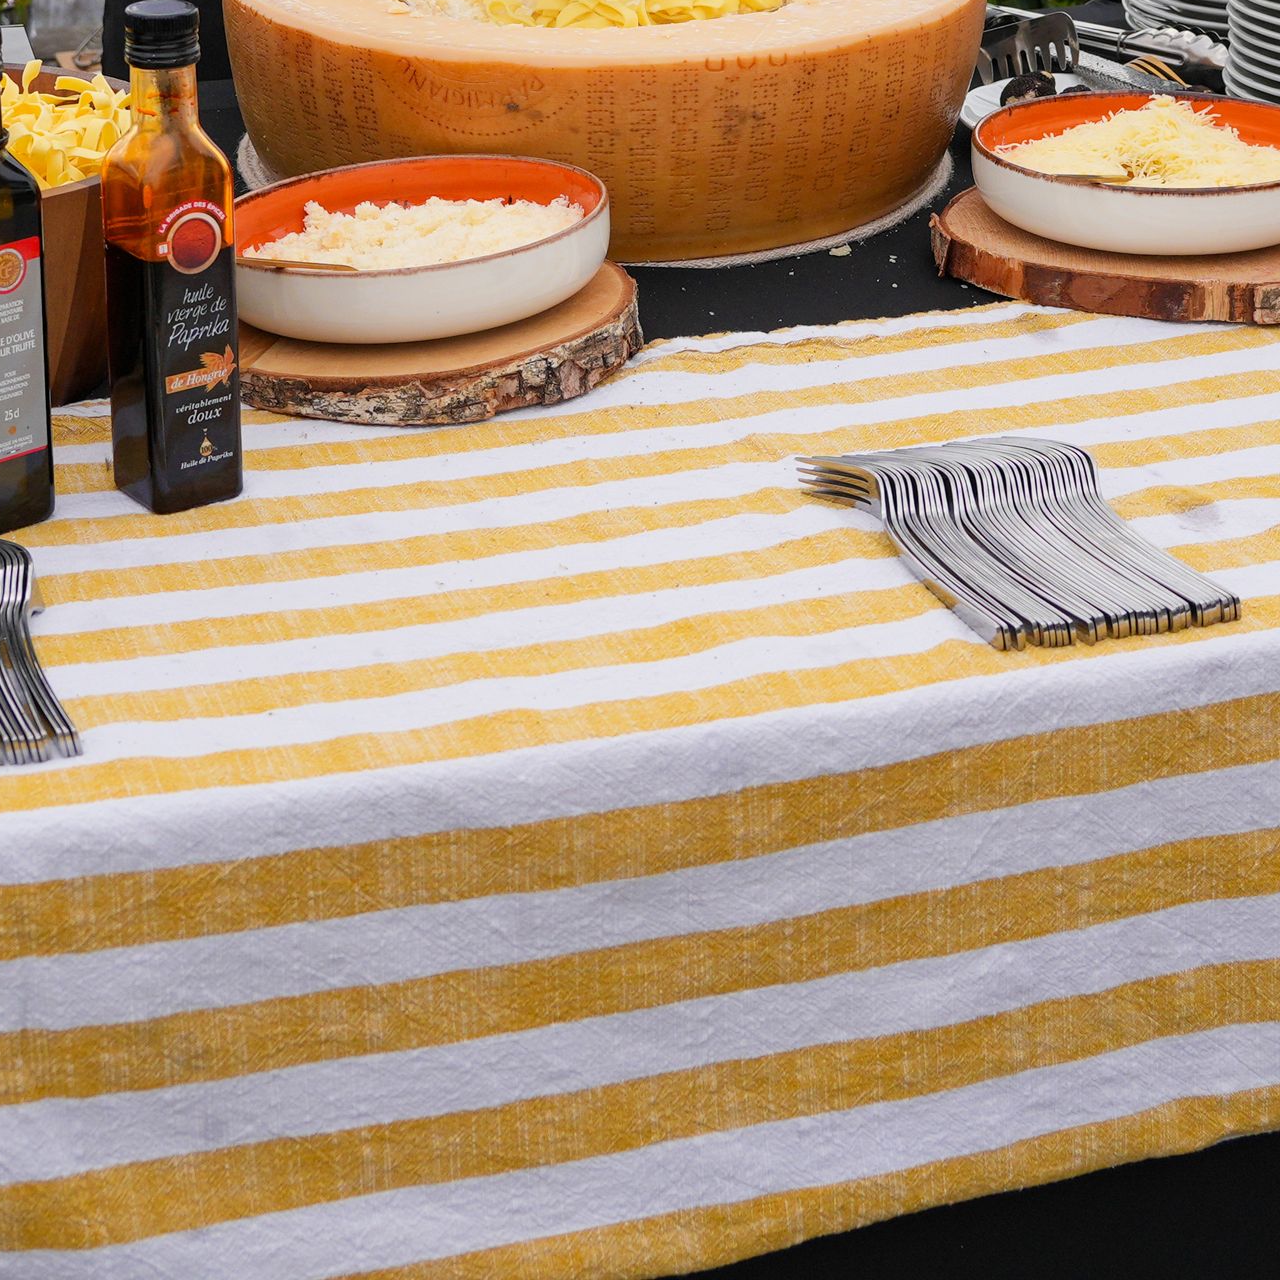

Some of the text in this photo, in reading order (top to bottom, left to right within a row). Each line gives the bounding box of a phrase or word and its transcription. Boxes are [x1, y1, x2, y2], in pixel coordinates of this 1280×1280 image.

[587, 69, 616, 209] REGGIA
[183, 283, 214, 304] huile
[167, 296, 227, 325] vierge de
[6, 328, 36, 345] D'OLIVE
[167, 314, 230, 352] Paprika
[11, 339, 36, 354] TRUFFE
[171, 368, 227, 389] de Hongrie
[176, 393, 232, 413] véritablement
[4, 409, 13, 421] 25
[187, 407, 222, 425] doux
[181, 460, 198, 470] Huile
[207, 451, 234, 463] Paprika
